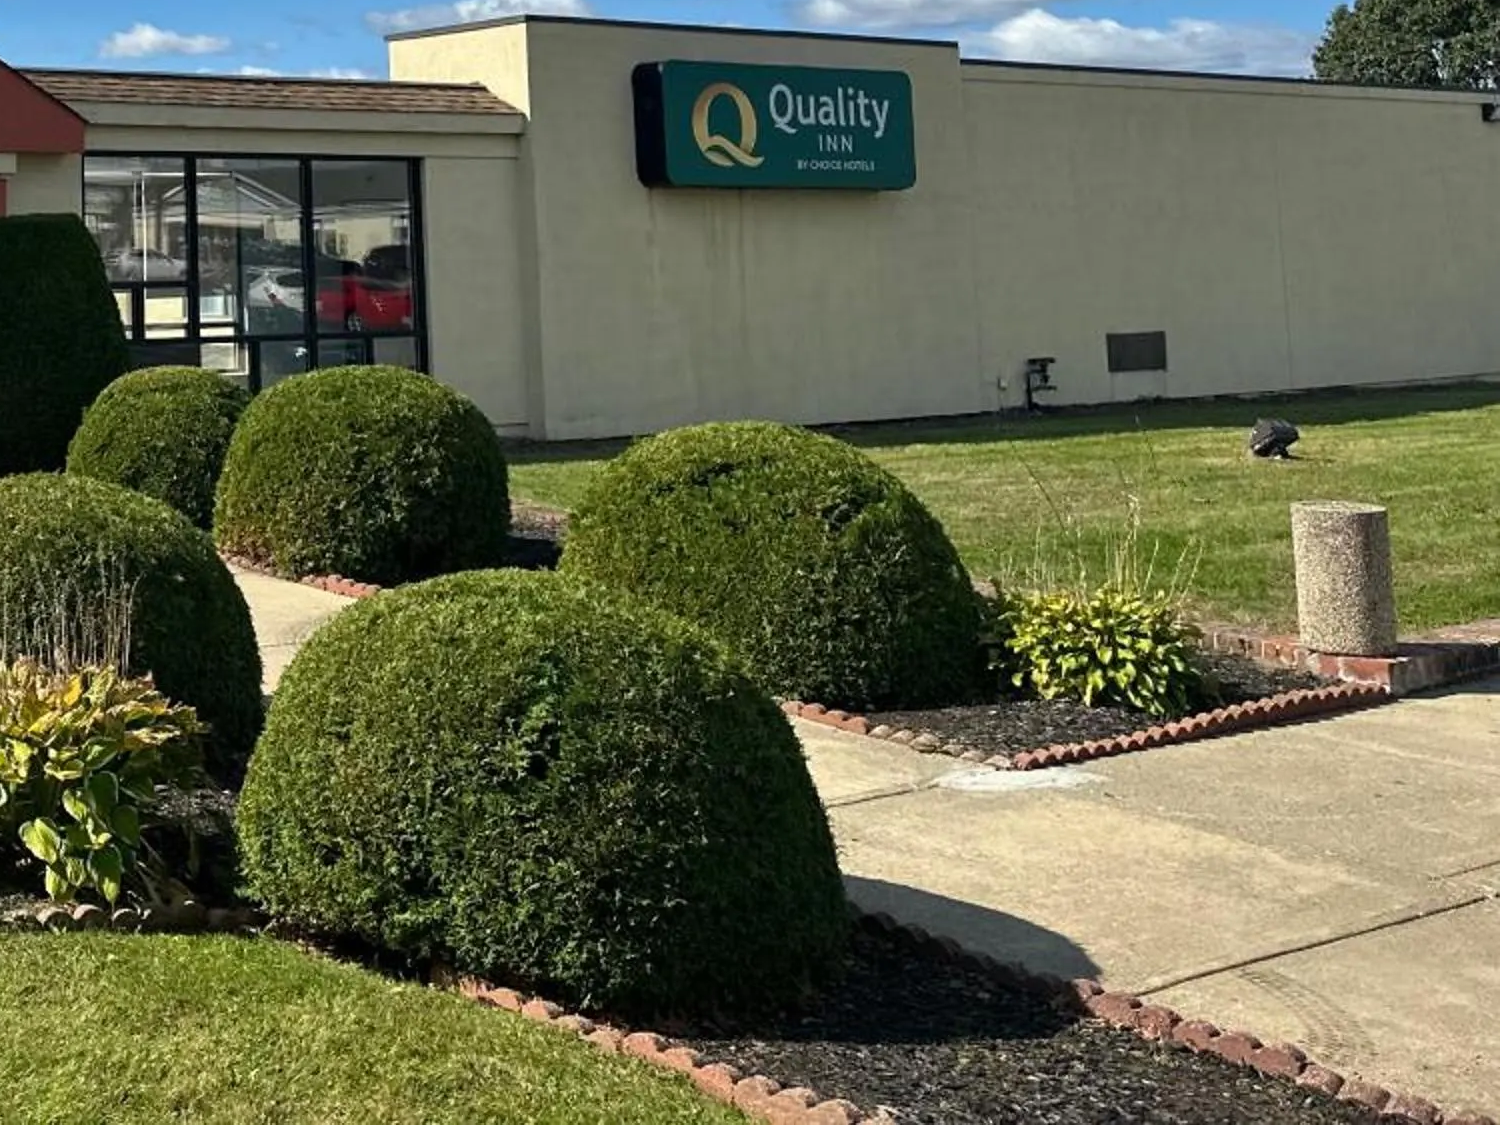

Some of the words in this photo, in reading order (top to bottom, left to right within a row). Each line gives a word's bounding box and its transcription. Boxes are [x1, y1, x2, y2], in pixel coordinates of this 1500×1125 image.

[692, 82, 765, 167] Q
[769, 83, 889, 139] Quality
[819, 135, 853, 152] INN
